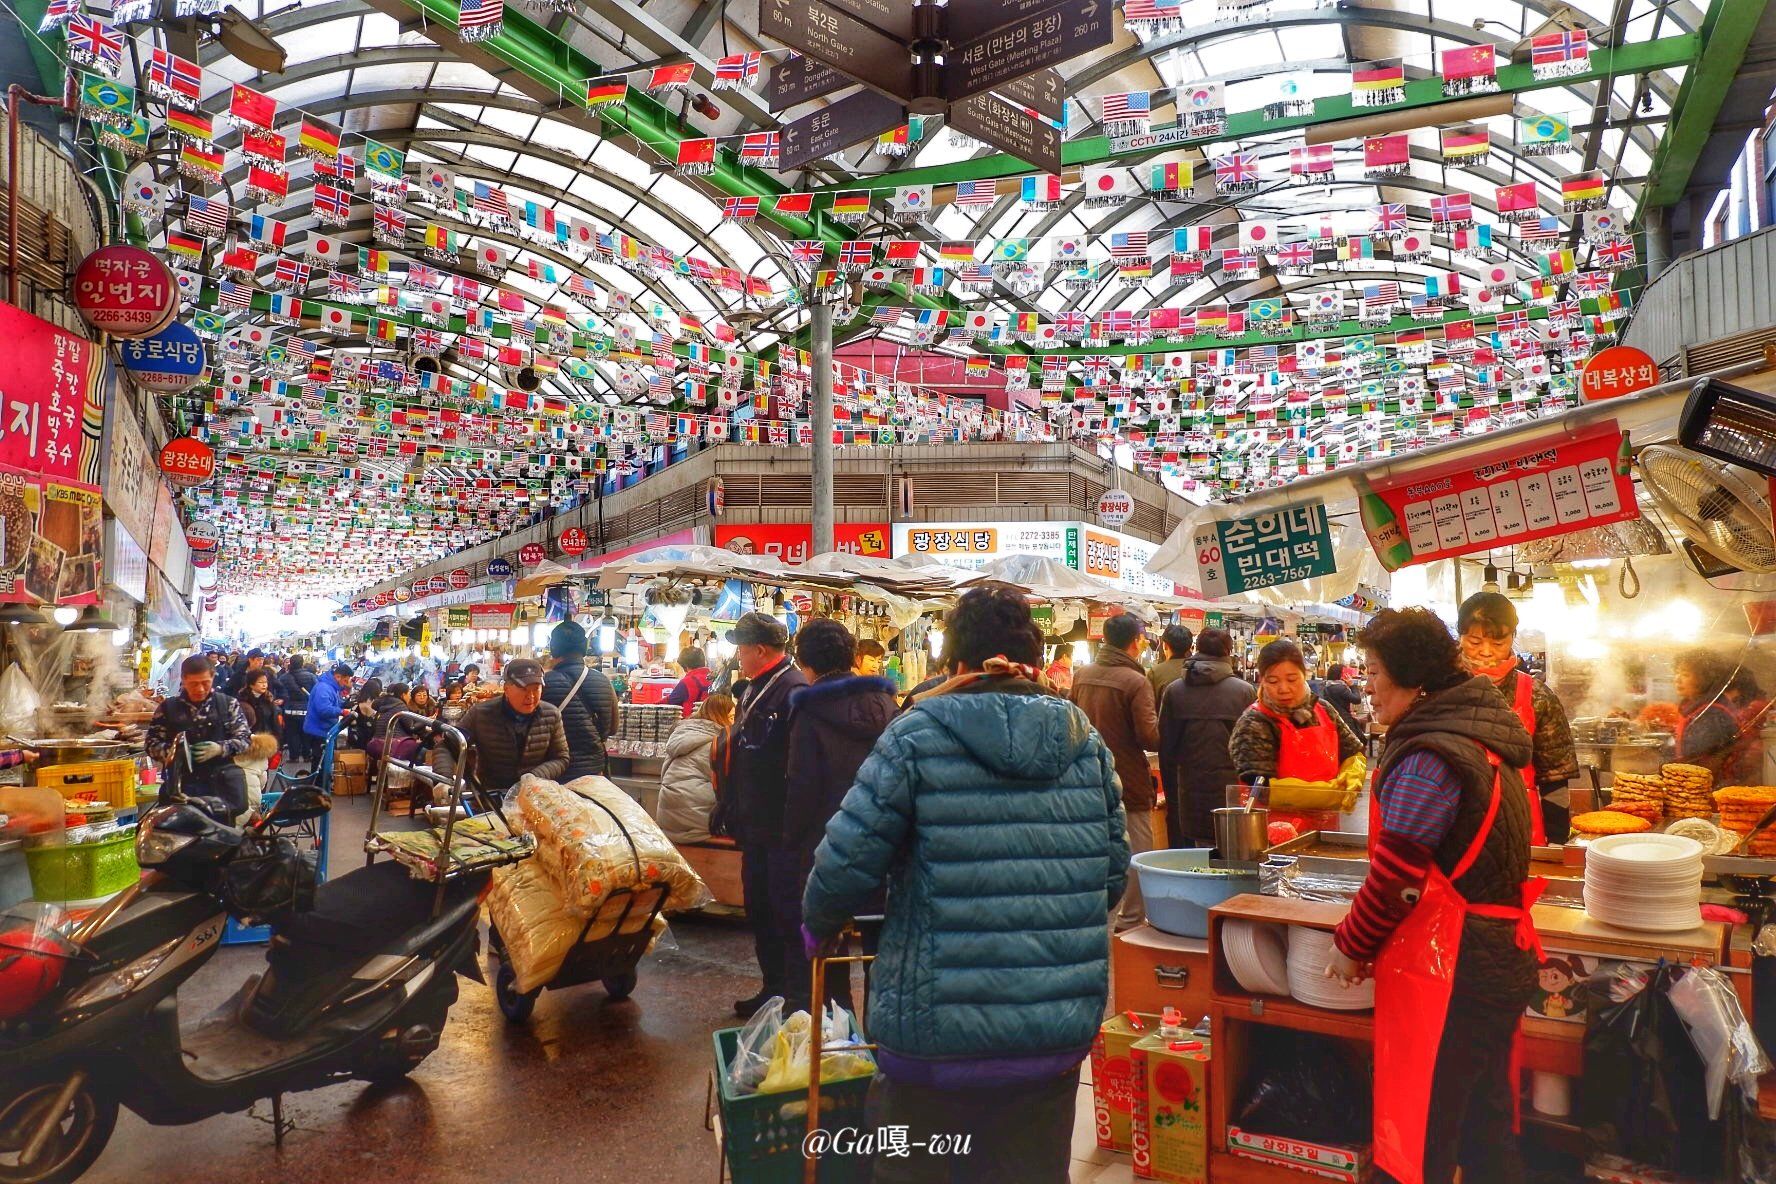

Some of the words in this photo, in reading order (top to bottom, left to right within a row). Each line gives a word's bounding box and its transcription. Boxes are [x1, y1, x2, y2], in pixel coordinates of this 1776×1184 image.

[773, 9, 783, 23] 60
[784, 16, 793, 28] m
[807, 5, 839, 36] 북2문
[1074, 23, 1088, 38] 260
[1089, 20, 1100, 32] m
[807, 26, 829, 46] North
[830, 38, 849, 54] Gate
[849, 47, 855, 58] 2
[961, 44, 984, 65] 서문
[986, 26, 1028, 57] (만남의
[1031, 11, 1063, 39] 광장)
[969, 63, 987, 77] West
[988, 56, 1006, 70] Gate
[1006, 44, 1039, 65] (Meeting
[1039, 34, 1063, 50] Plaza)
[967, 95, 987, 111] 문
[811, 112, 831, 133] 동문
[967, 107, 986, 123] South
[824, 127, 840, 139] Gate
[1130, 135, 1158, 148] CCTV
[1158, 129, 1190, 143] 24시간
[1190, 124, 1220, 137] 녹화중
[80, 281, 163, 308] 일번지
[93, 310, 153, 324] 2266-3439
[128, 338, 200, 365] 종로식당
[1584, 363, 1656, 392] 대복상회
[163, 450, 213, 473] 광장순대
[55, 487, 69, 500] KBS
[1100, 501, 1130, 513] 광장식당
[1224, 503, 1324, 555] 순희네
[913, 531, 991, 552] 광장식당
[1087, 538, 1121, 574] 광장식당
[1199, 546, 1221, 566] 60
[1237, 539, 1321, 577] 빈대떡
[1206, 568, 1218, 581] 호
[1243, 564, 1313, 591] 2263-7567
[196, 925, 218, 947] S&T
